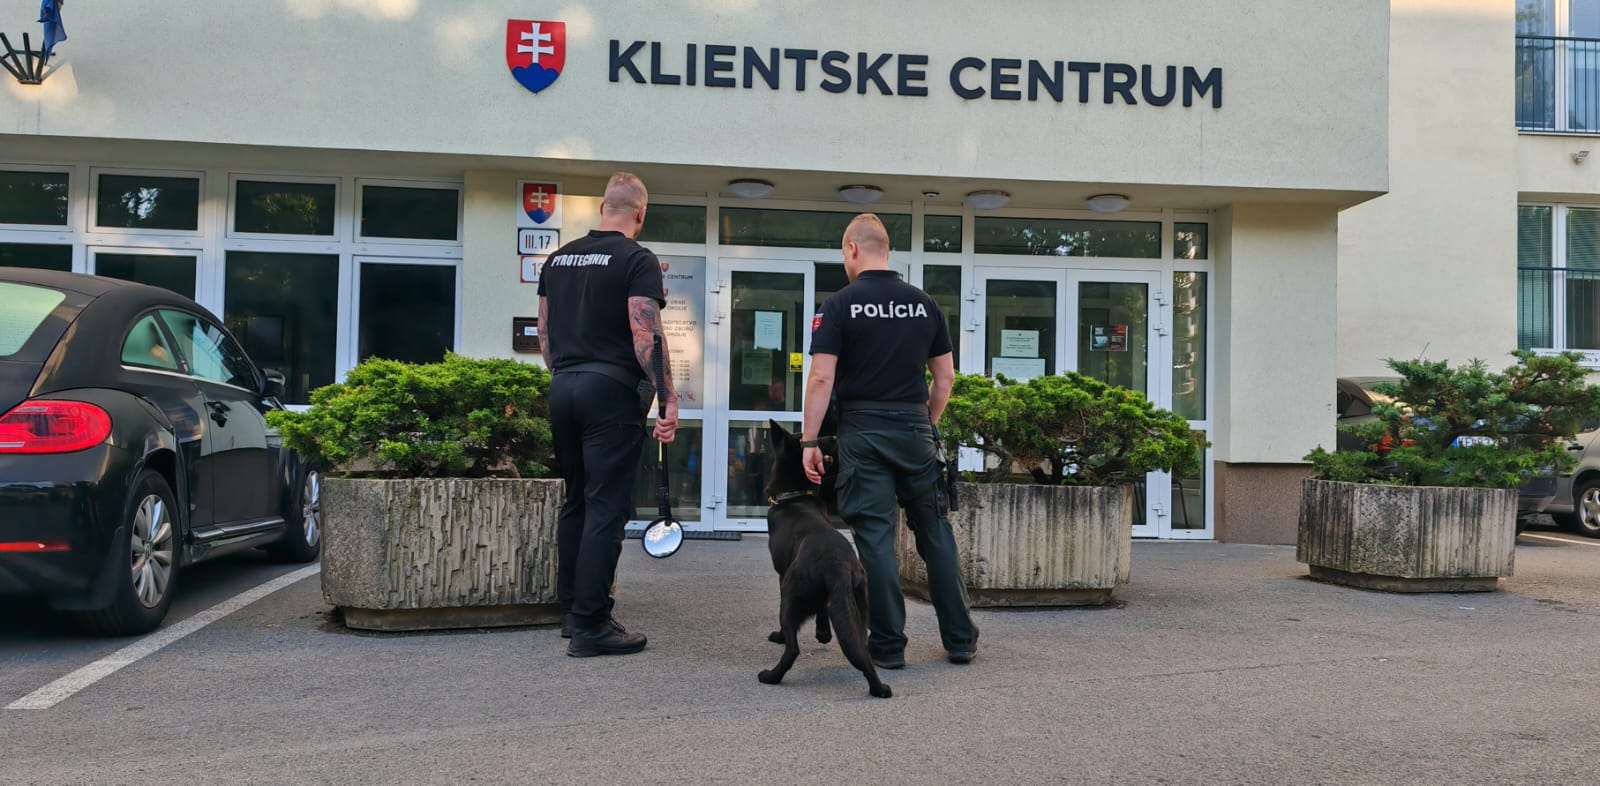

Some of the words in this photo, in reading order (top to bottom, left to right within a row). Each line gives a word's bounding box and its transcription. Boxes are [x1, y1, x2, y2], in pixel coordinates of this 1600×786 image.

[608, 39, 928, 97] KLIENTSKE
[949, 57, 1223, 108] CENTRUM
[551, 253, 612, 267] PYROTECHNIK
[850, 301, 928, 318] POLÍCIA
